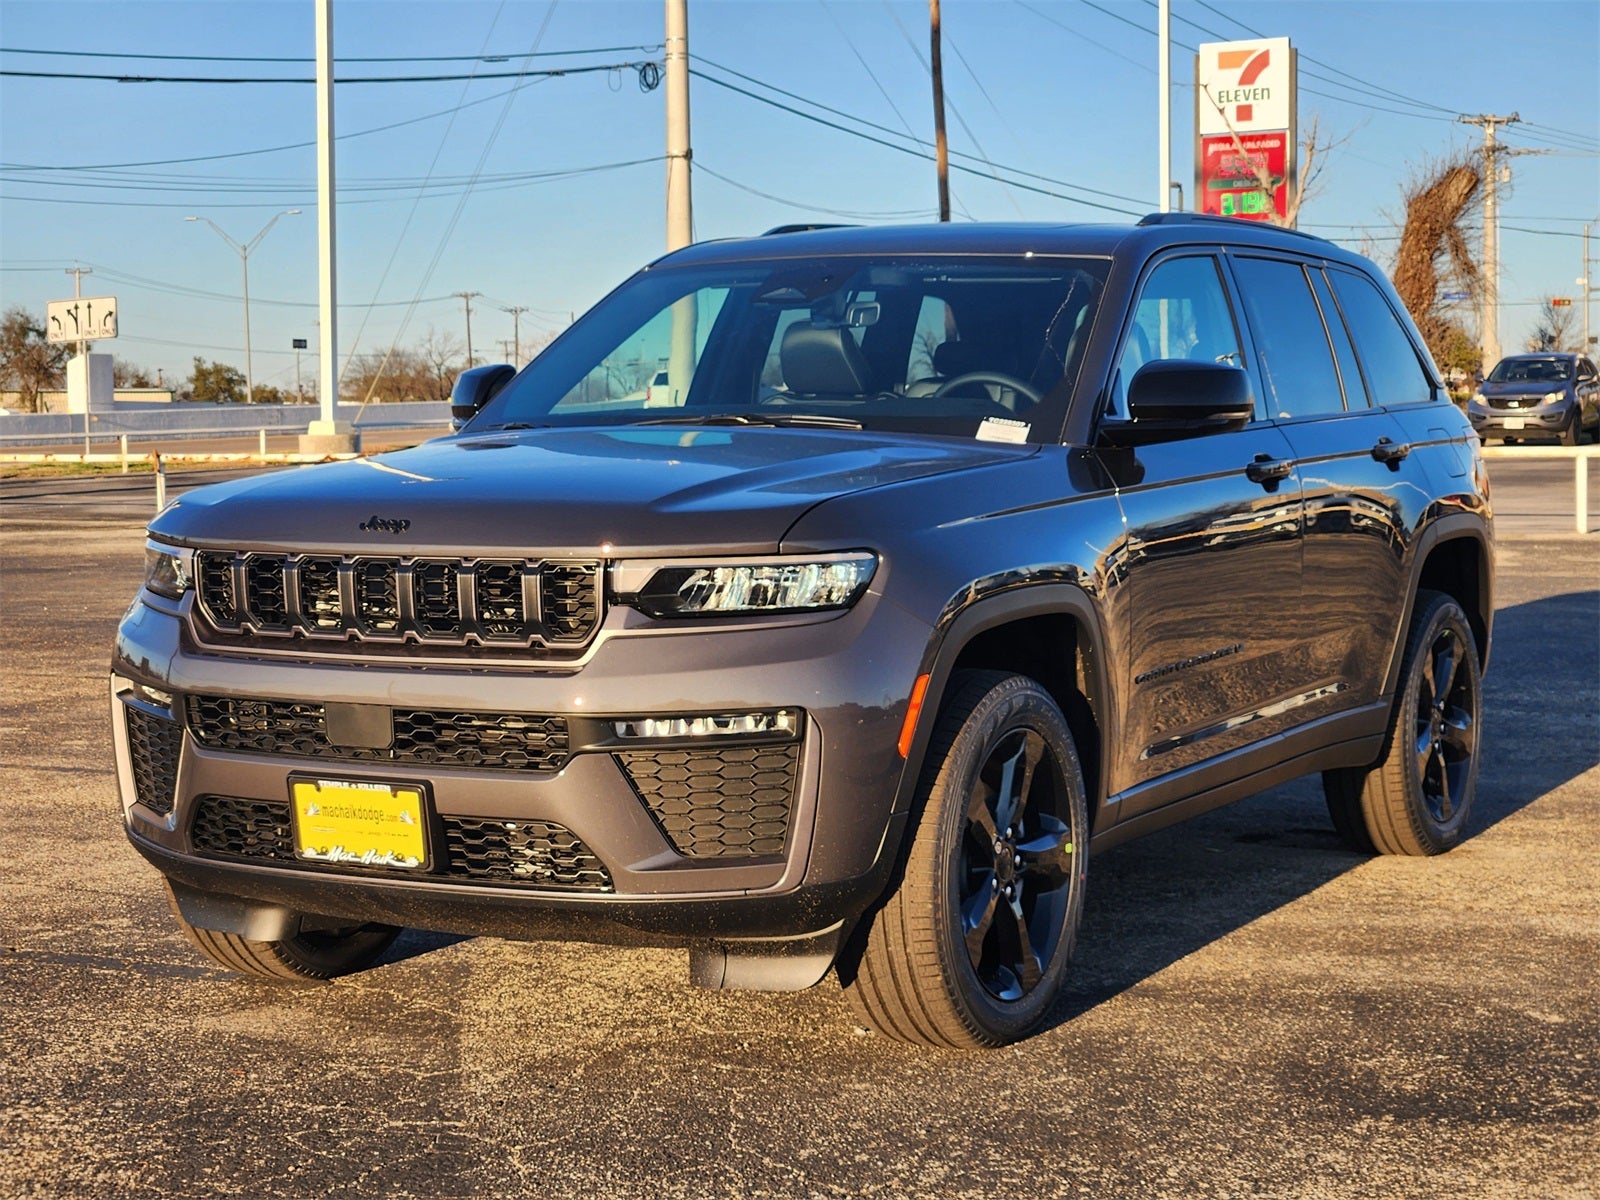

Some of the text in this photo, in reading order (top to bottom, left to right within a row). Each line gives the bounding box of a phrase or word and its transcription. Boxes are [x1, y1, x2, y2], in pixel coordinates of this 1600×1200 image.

[101, 327, 115, 335] ONLY
[359, 515, 411, 535] Jeep
[326, 845, 396, 865] Mac Haik
